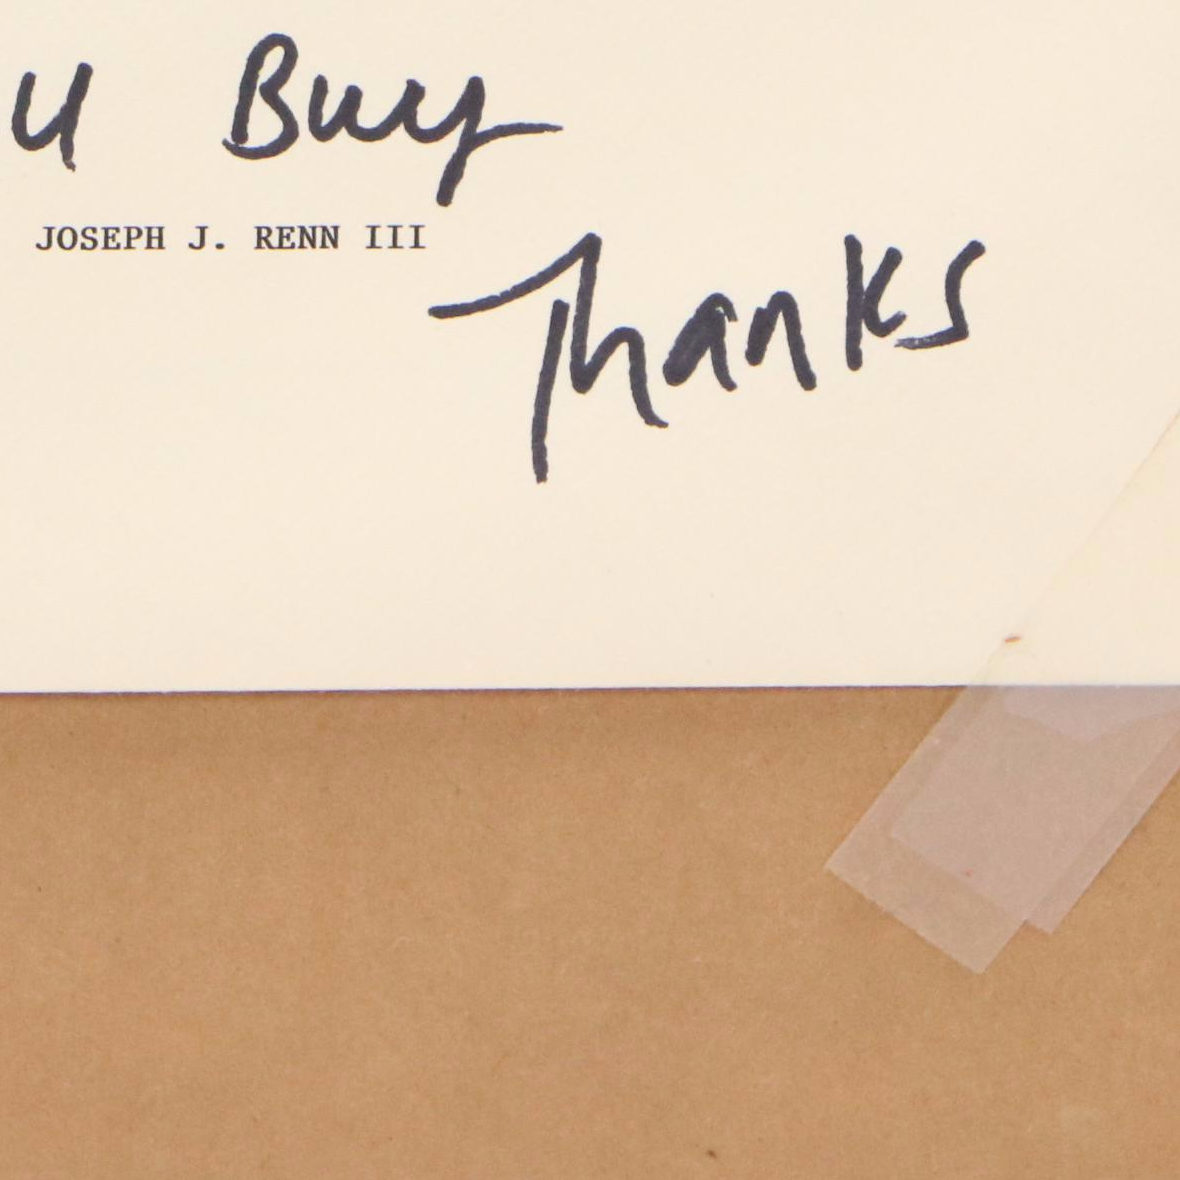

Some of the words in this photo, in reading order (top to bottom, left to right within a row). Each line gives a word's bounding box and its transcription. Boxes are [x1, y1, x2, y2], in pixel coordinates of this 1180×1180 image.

[222, 33, 563, 207] Buy
[35, 225, 166, 251] JOSEPH
[188, 225, 225, 251] J.
[254, 225, 340, 251] RENN
[365, 224, 426, 250] III
[428, 233, 986, 484] Thanks
